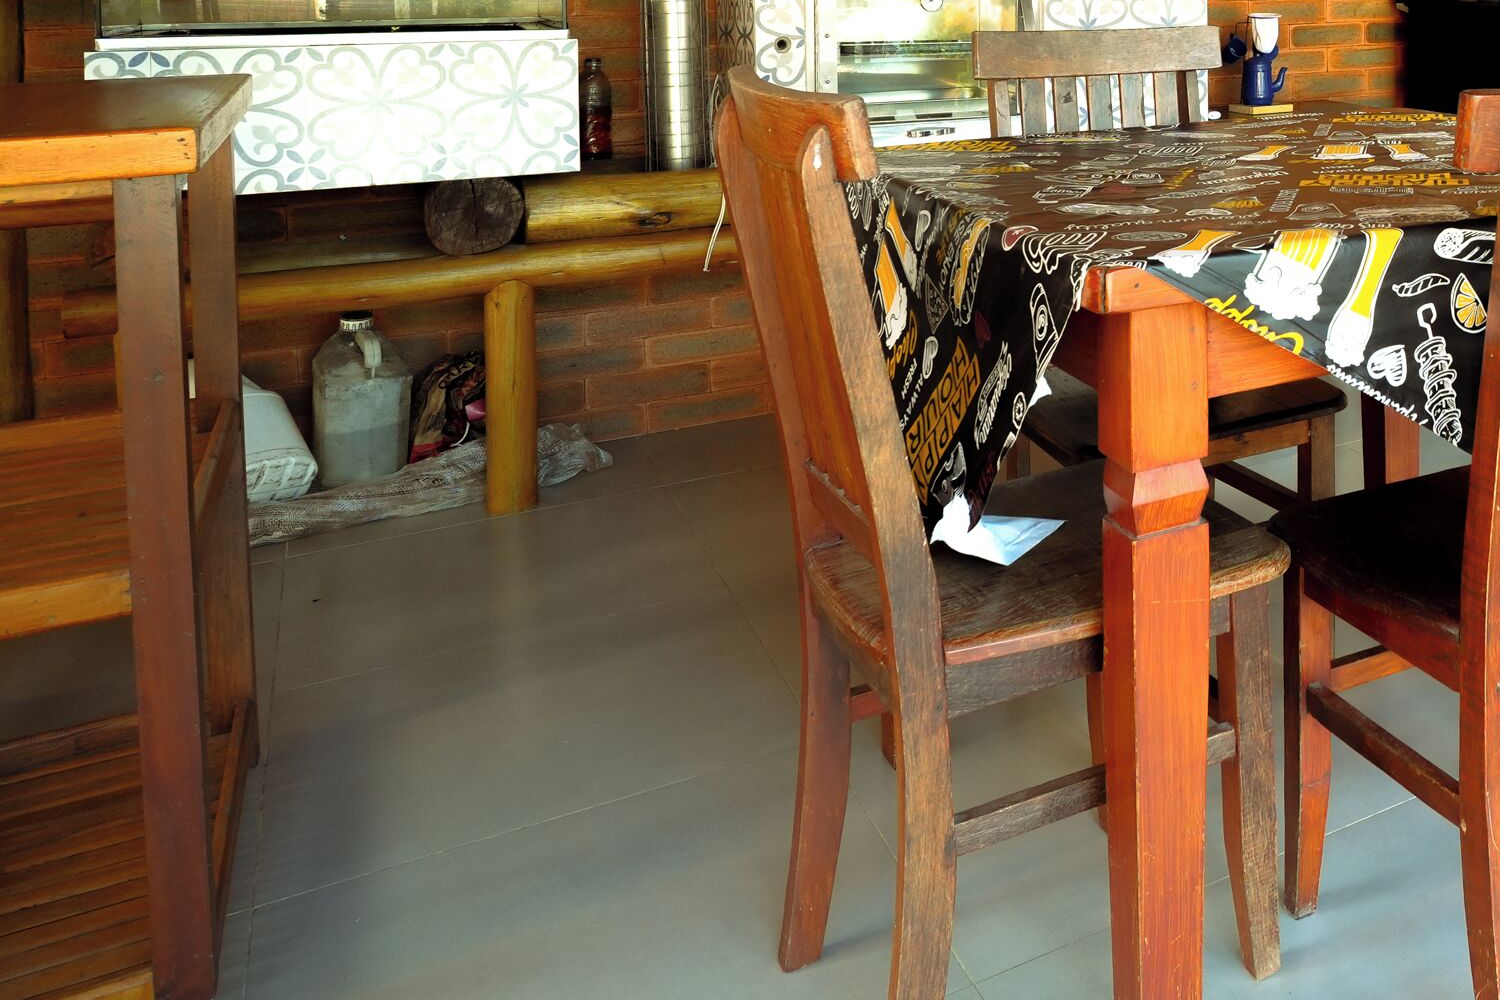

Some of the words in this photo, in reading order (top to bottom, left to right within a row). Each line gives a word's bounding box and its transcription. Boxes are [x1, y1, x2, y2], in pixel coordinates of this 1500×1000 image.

[1063, 218, 1153, 232] quality
[887, 309, 918, 381] Chop
[899, 372, 924, 431] ALWAYS
[901, 358, 918, 399] FRESH
[905, 337, 970, 460] HOUR
[911, 354, 980, 502] HAPPY
